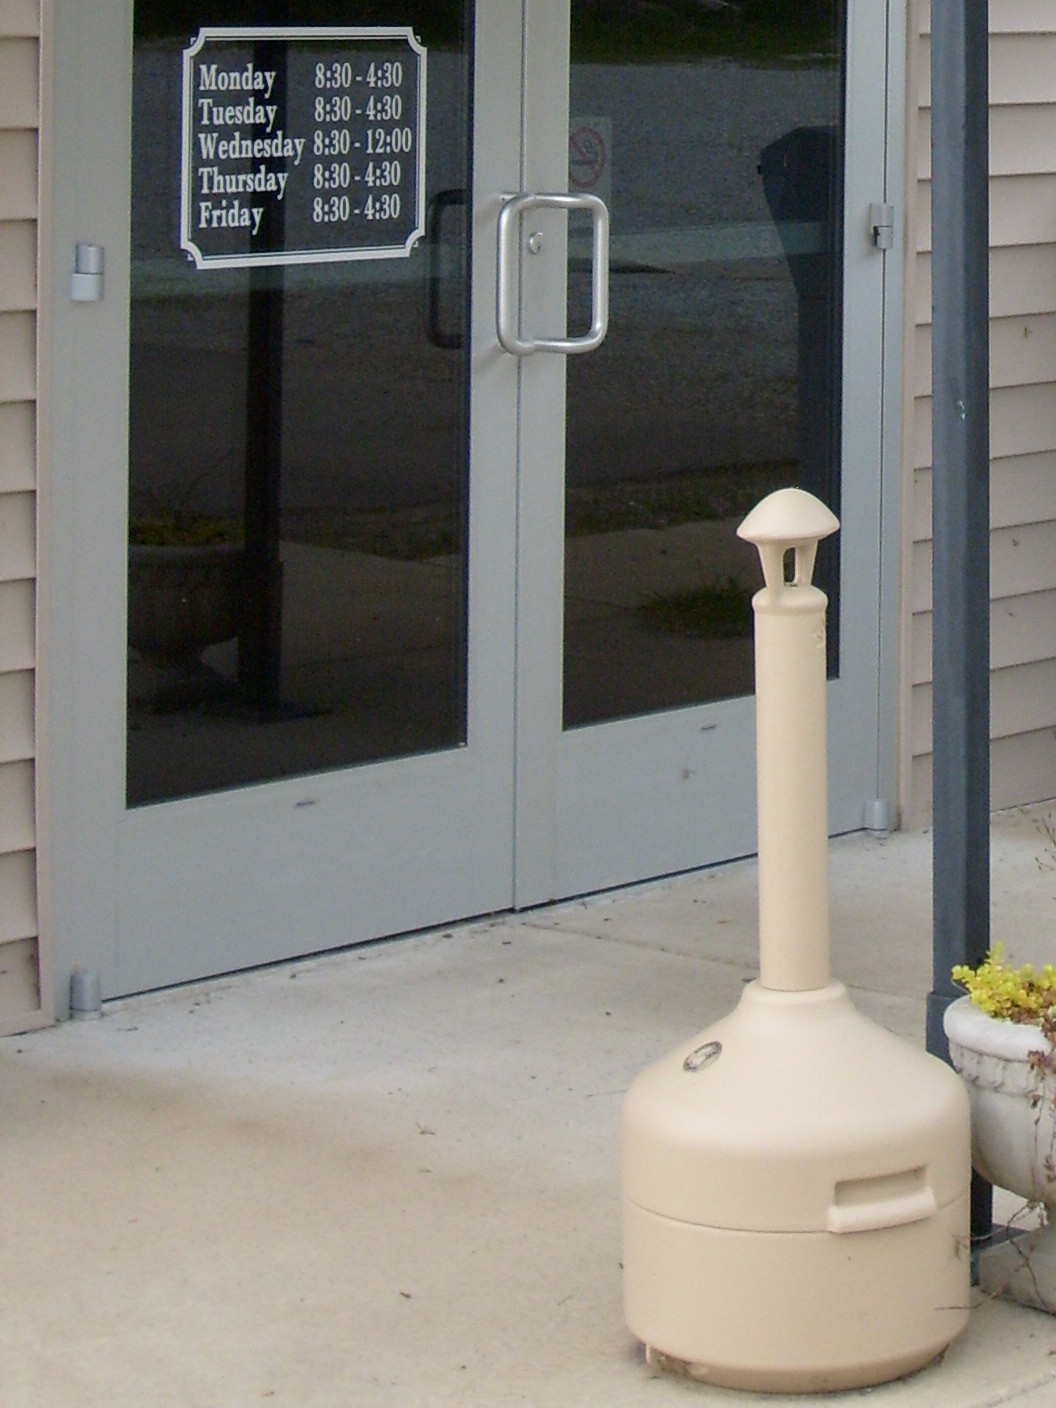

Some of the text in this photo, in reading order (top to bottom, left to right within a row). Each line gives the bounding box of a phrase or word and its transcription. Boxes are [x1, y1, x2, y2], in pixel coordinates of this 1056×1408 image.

[199, 64, 275, 99] Monday
[316, 63, 351, 88] 8:30
[367, 62, 402, 87] 4:30
[199, 97, 277, 132] Tuesday
[315, 96, 351, 121] 8:30
[366, 95, 401, 120] 4:30
[198, 130, 305, 165] Wednesday
[314, 129, 349, 155] 8:30
[367, 128, 411, 153] 12:00
[199, 165, 288, 200] Thursday
[314, 163, 350, 188] 8:30
[365, 161, 400, 186] 4:30
[199, 200, 263, 235] Friday
[313, 196, 349, 222] 8:30
[365, 194, 400, 219] 4:30
